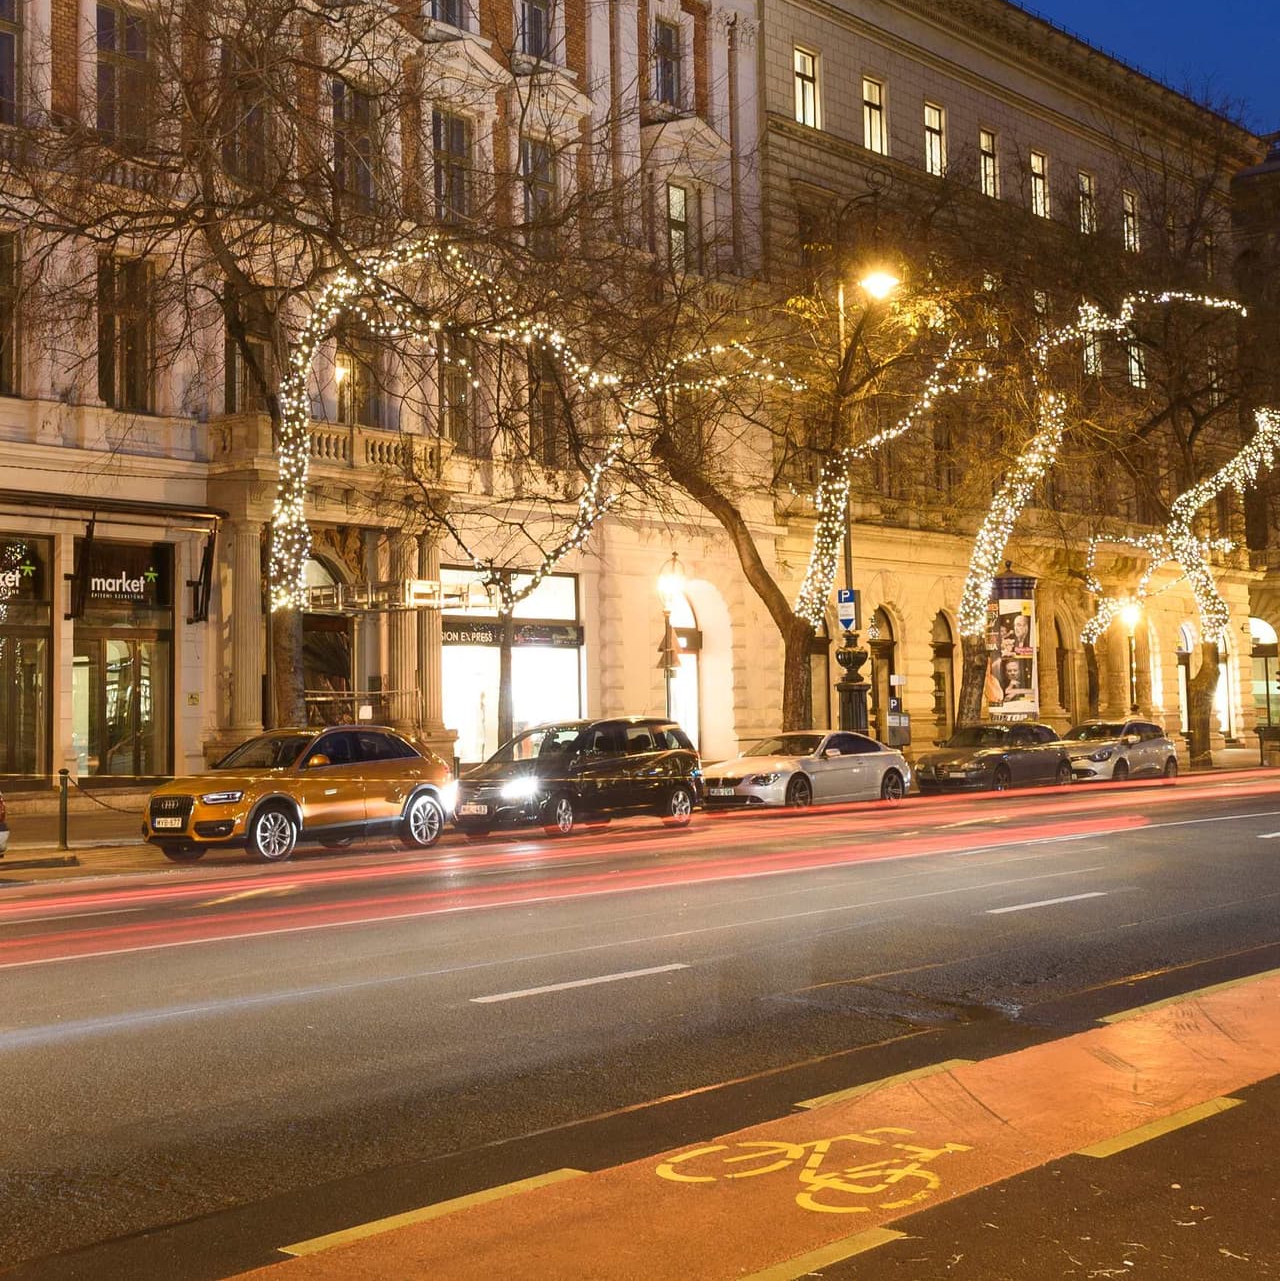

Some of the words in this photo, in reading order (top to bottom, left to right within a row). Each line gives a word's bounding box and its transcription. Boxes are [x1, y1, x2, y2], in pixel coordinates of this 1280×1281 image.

[91, 570, 146, 593] market
[841, 590, 850, 602] P
[441, 631, 459, 643] SION
[460, 630, 493, 644] EXPRESS
[890, 699, 898, 709] P
